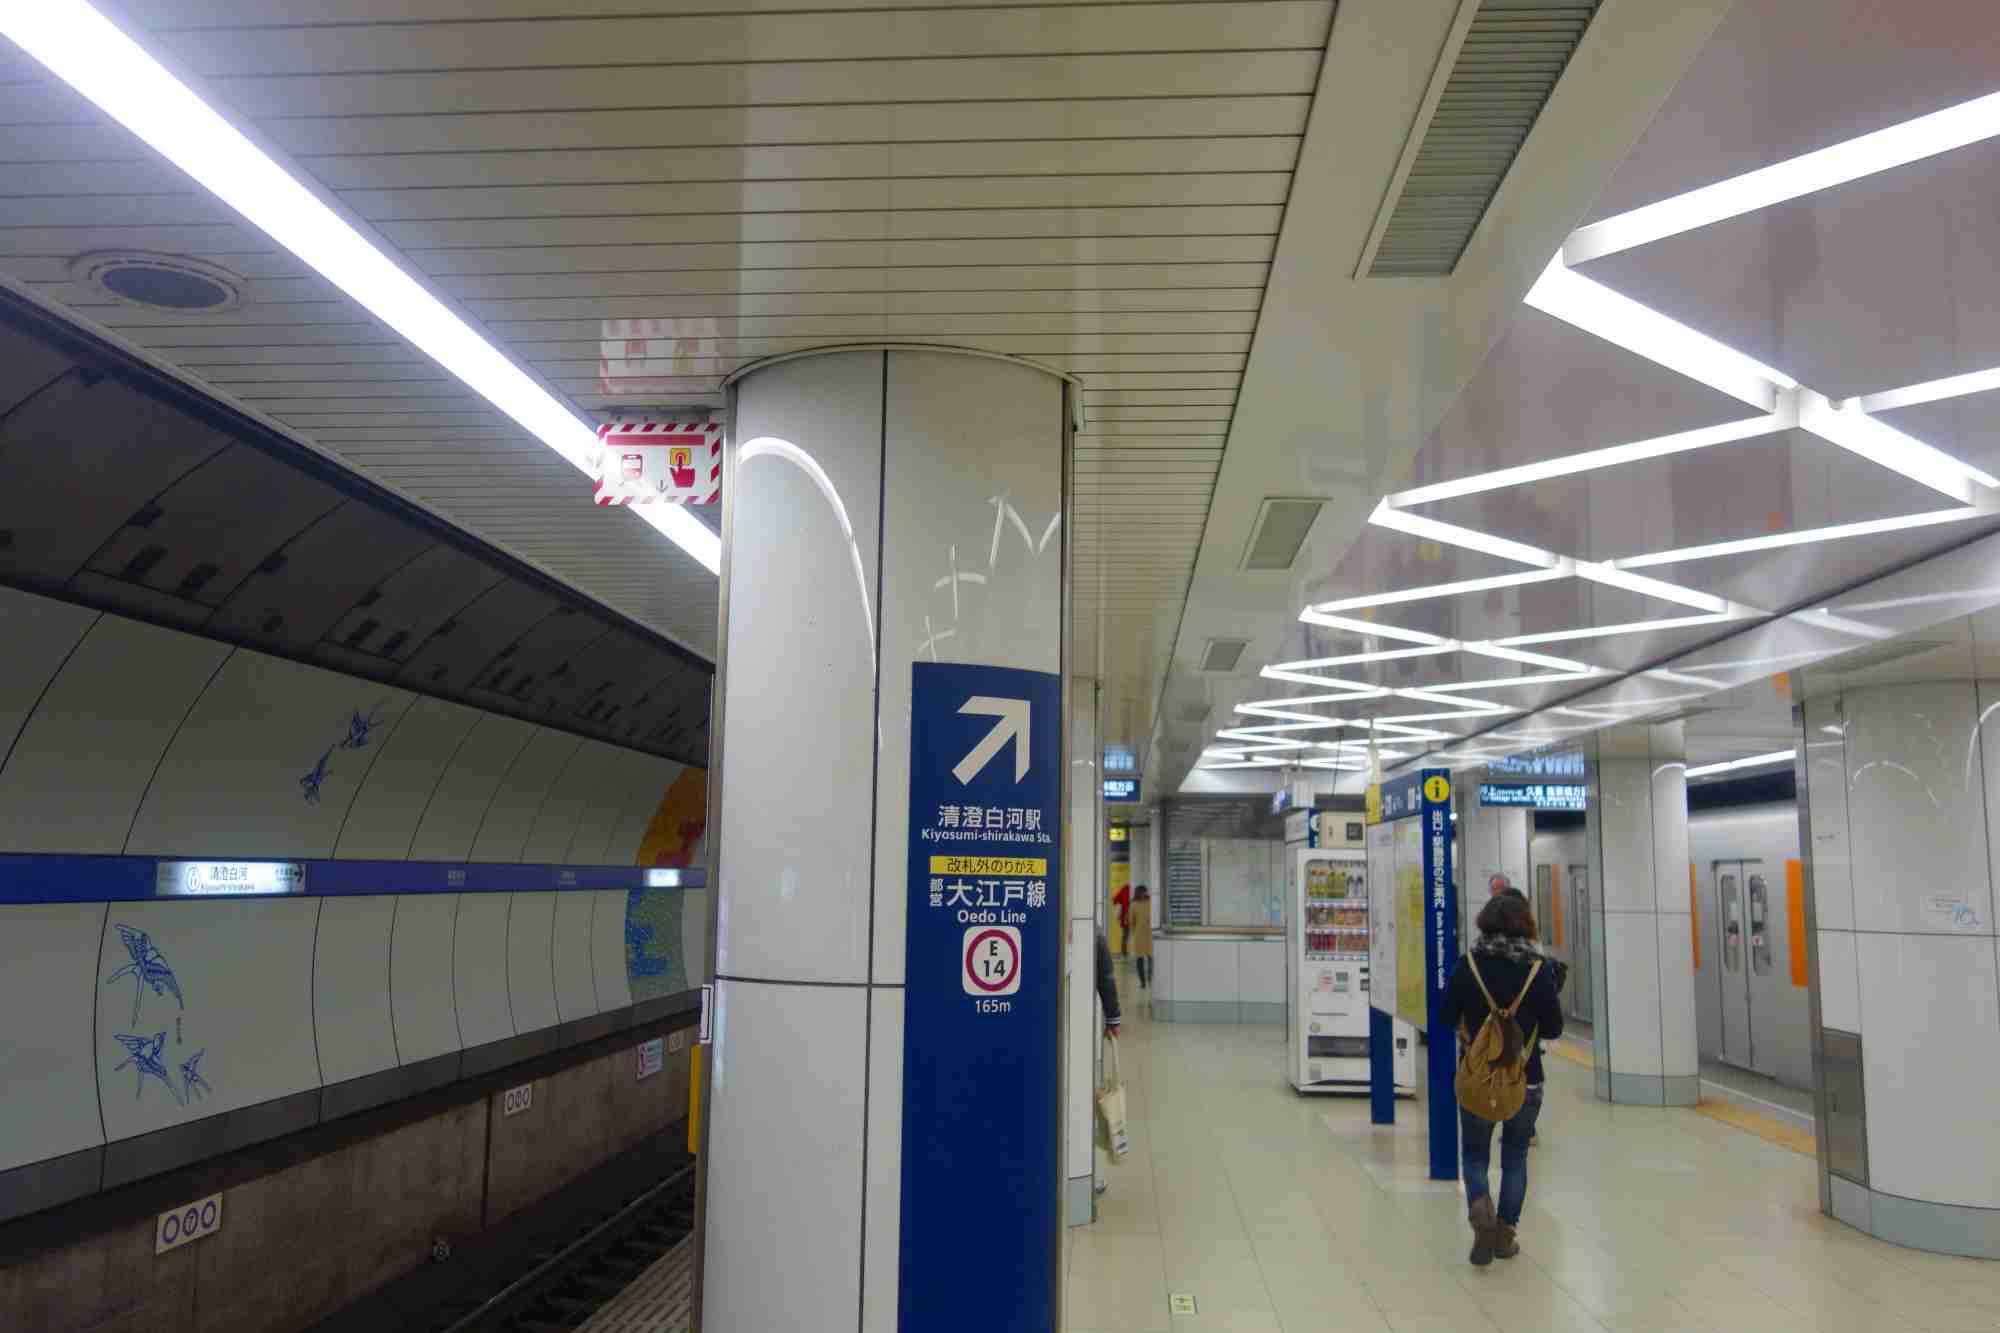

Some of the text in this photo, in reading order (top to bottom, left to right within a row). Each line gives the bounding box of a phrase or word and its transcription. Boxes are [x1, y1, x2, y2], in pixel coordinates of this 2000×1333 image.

[938, 805, 1041, 830] 清澄白河駅
[921, 828, 1034, 842] Kiyosumi-shirakawa
[947, 857, 1036, 874] 改札外のりかえ
[947, 879, 1046, 907] 大江戸線
[957, 909, 1027, 924] Oedo Line
[989, 940, 998, 957] E
[983, 959, 1006, 977] 14
[976, 999, 1010, 1013] 165m
